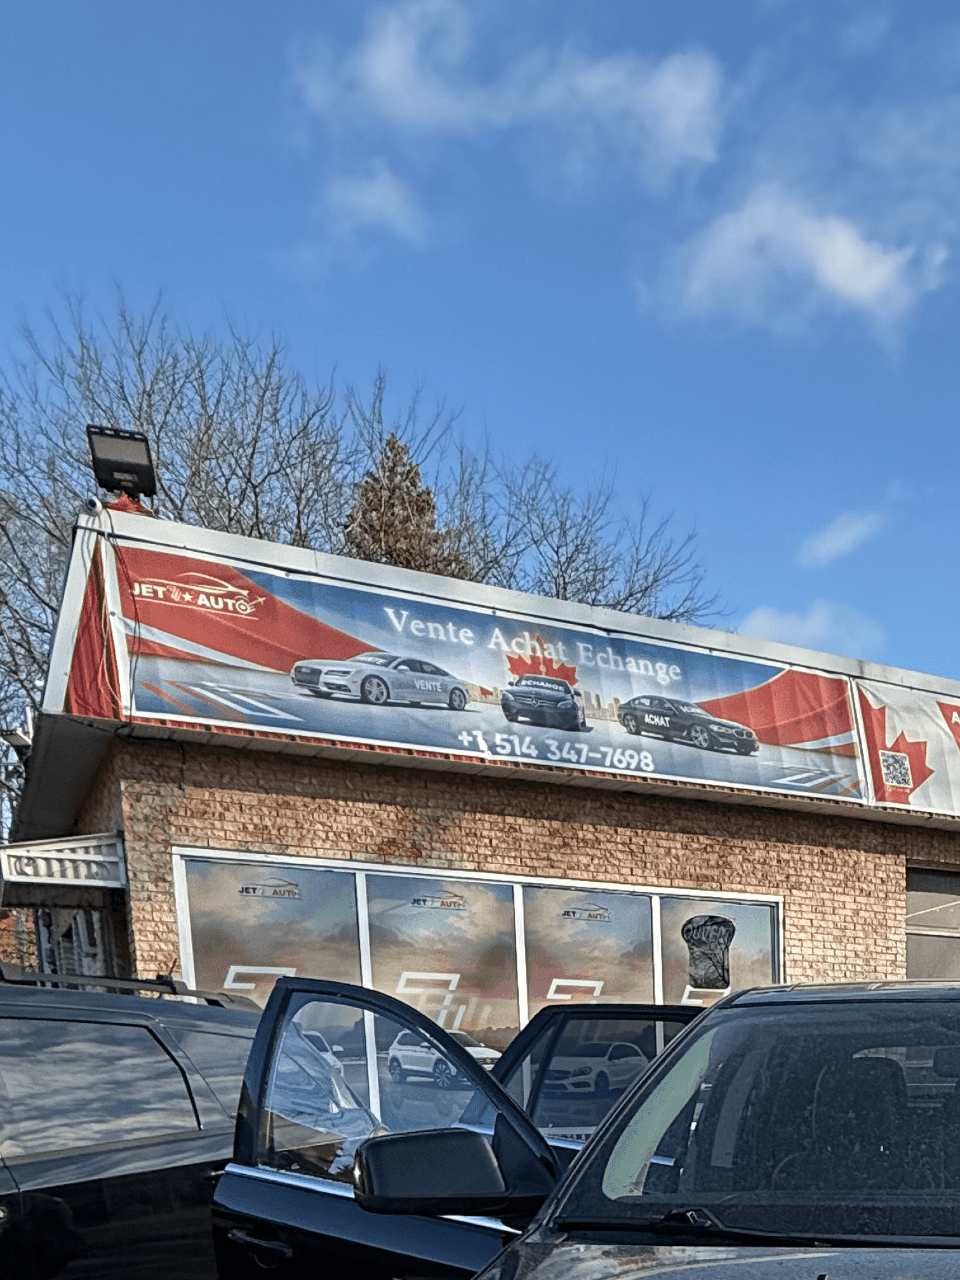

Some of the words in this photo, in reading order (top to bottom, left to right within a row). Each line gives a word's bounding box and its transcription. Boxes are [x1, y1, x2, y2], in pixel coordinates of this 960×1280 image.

[132, 583, 167, 598] JET
[383, 606, 475, 646] Vente
[487, 627, 569, 663] Achat
[576, 641, 682, 686] Echange
[414, 678, 442, 692] VENTE
[644, 713, 671, 728] ACHAT
[495, 733, 538, 758] 514
[545, 739, 655, 773] 347-7698
[238, 886, 258, 895] JET
[410, 898, 428, 907] JET
